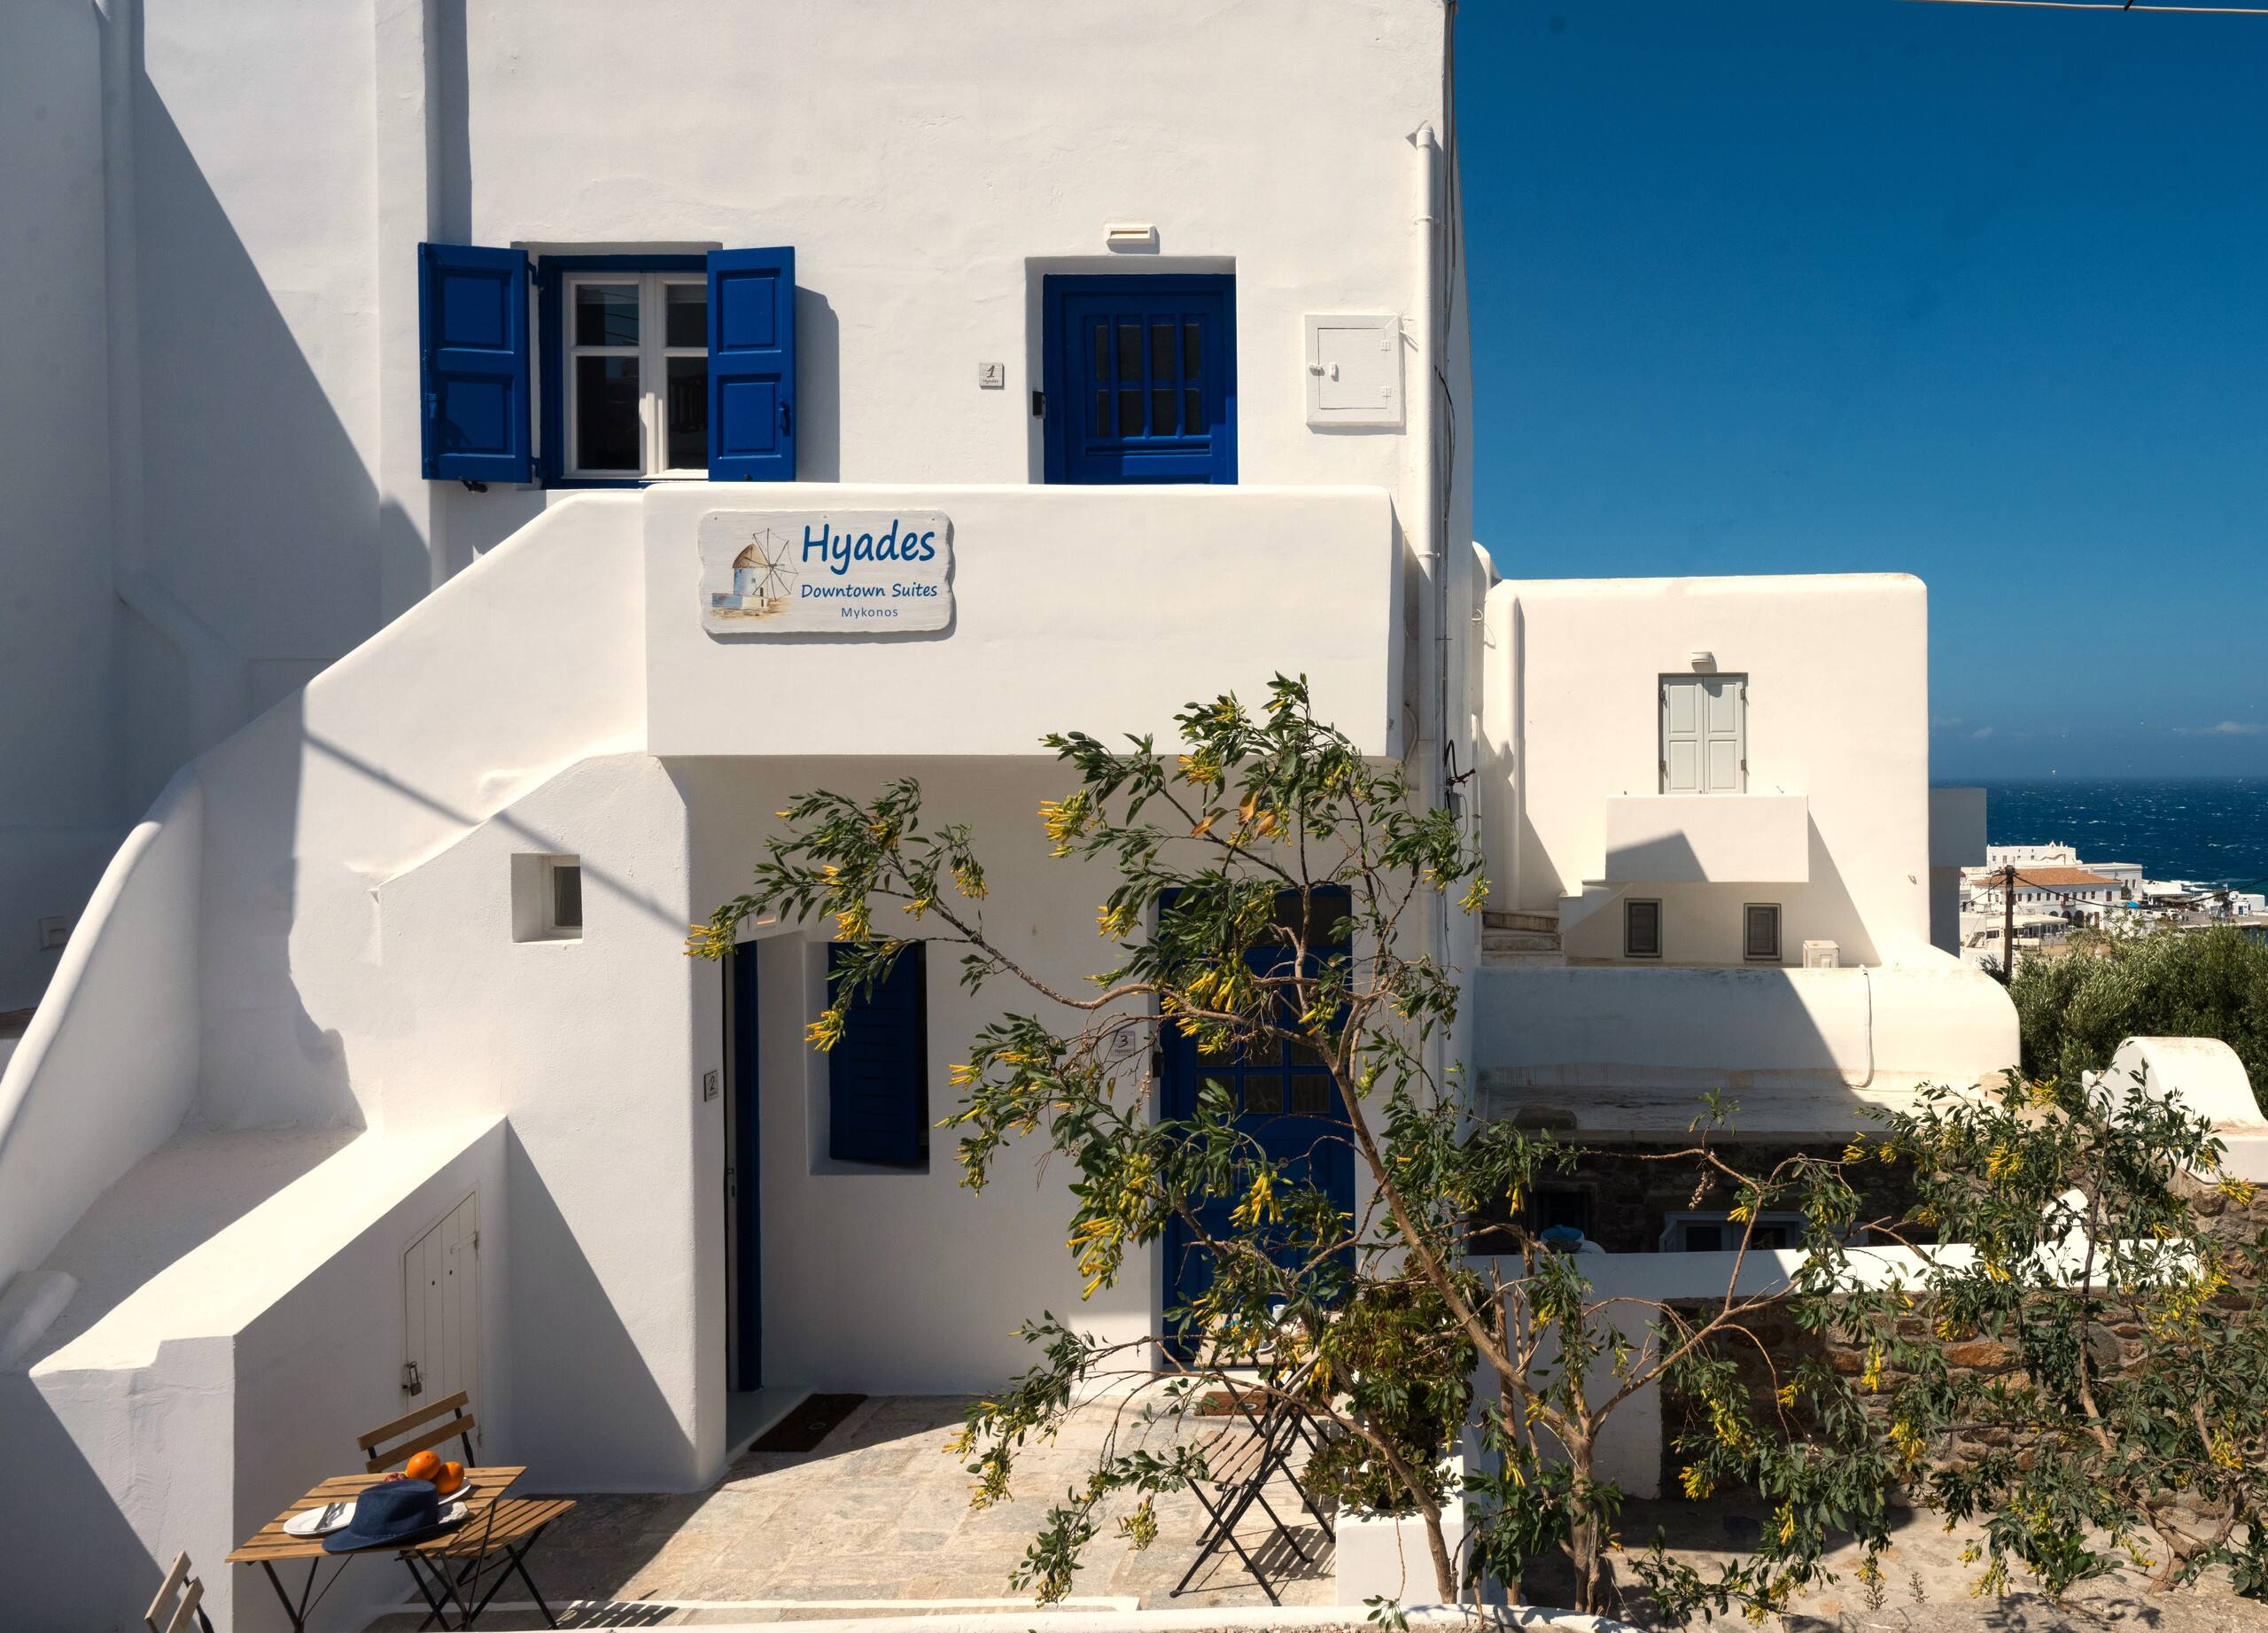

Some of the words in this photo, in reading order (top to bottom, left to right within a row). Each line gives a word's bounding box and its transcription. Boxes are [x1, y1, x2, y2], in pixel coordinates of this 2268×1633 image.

[986, 364, 995, 378] 1
[802, 518, 936, 575] Hyades
[801, 584, 885, 599] Downtown
[891, 581, 938, 598] Suites
[841, 606, 898, 619] Mykonos
[1118, 1035, 1129, 1048] 3
